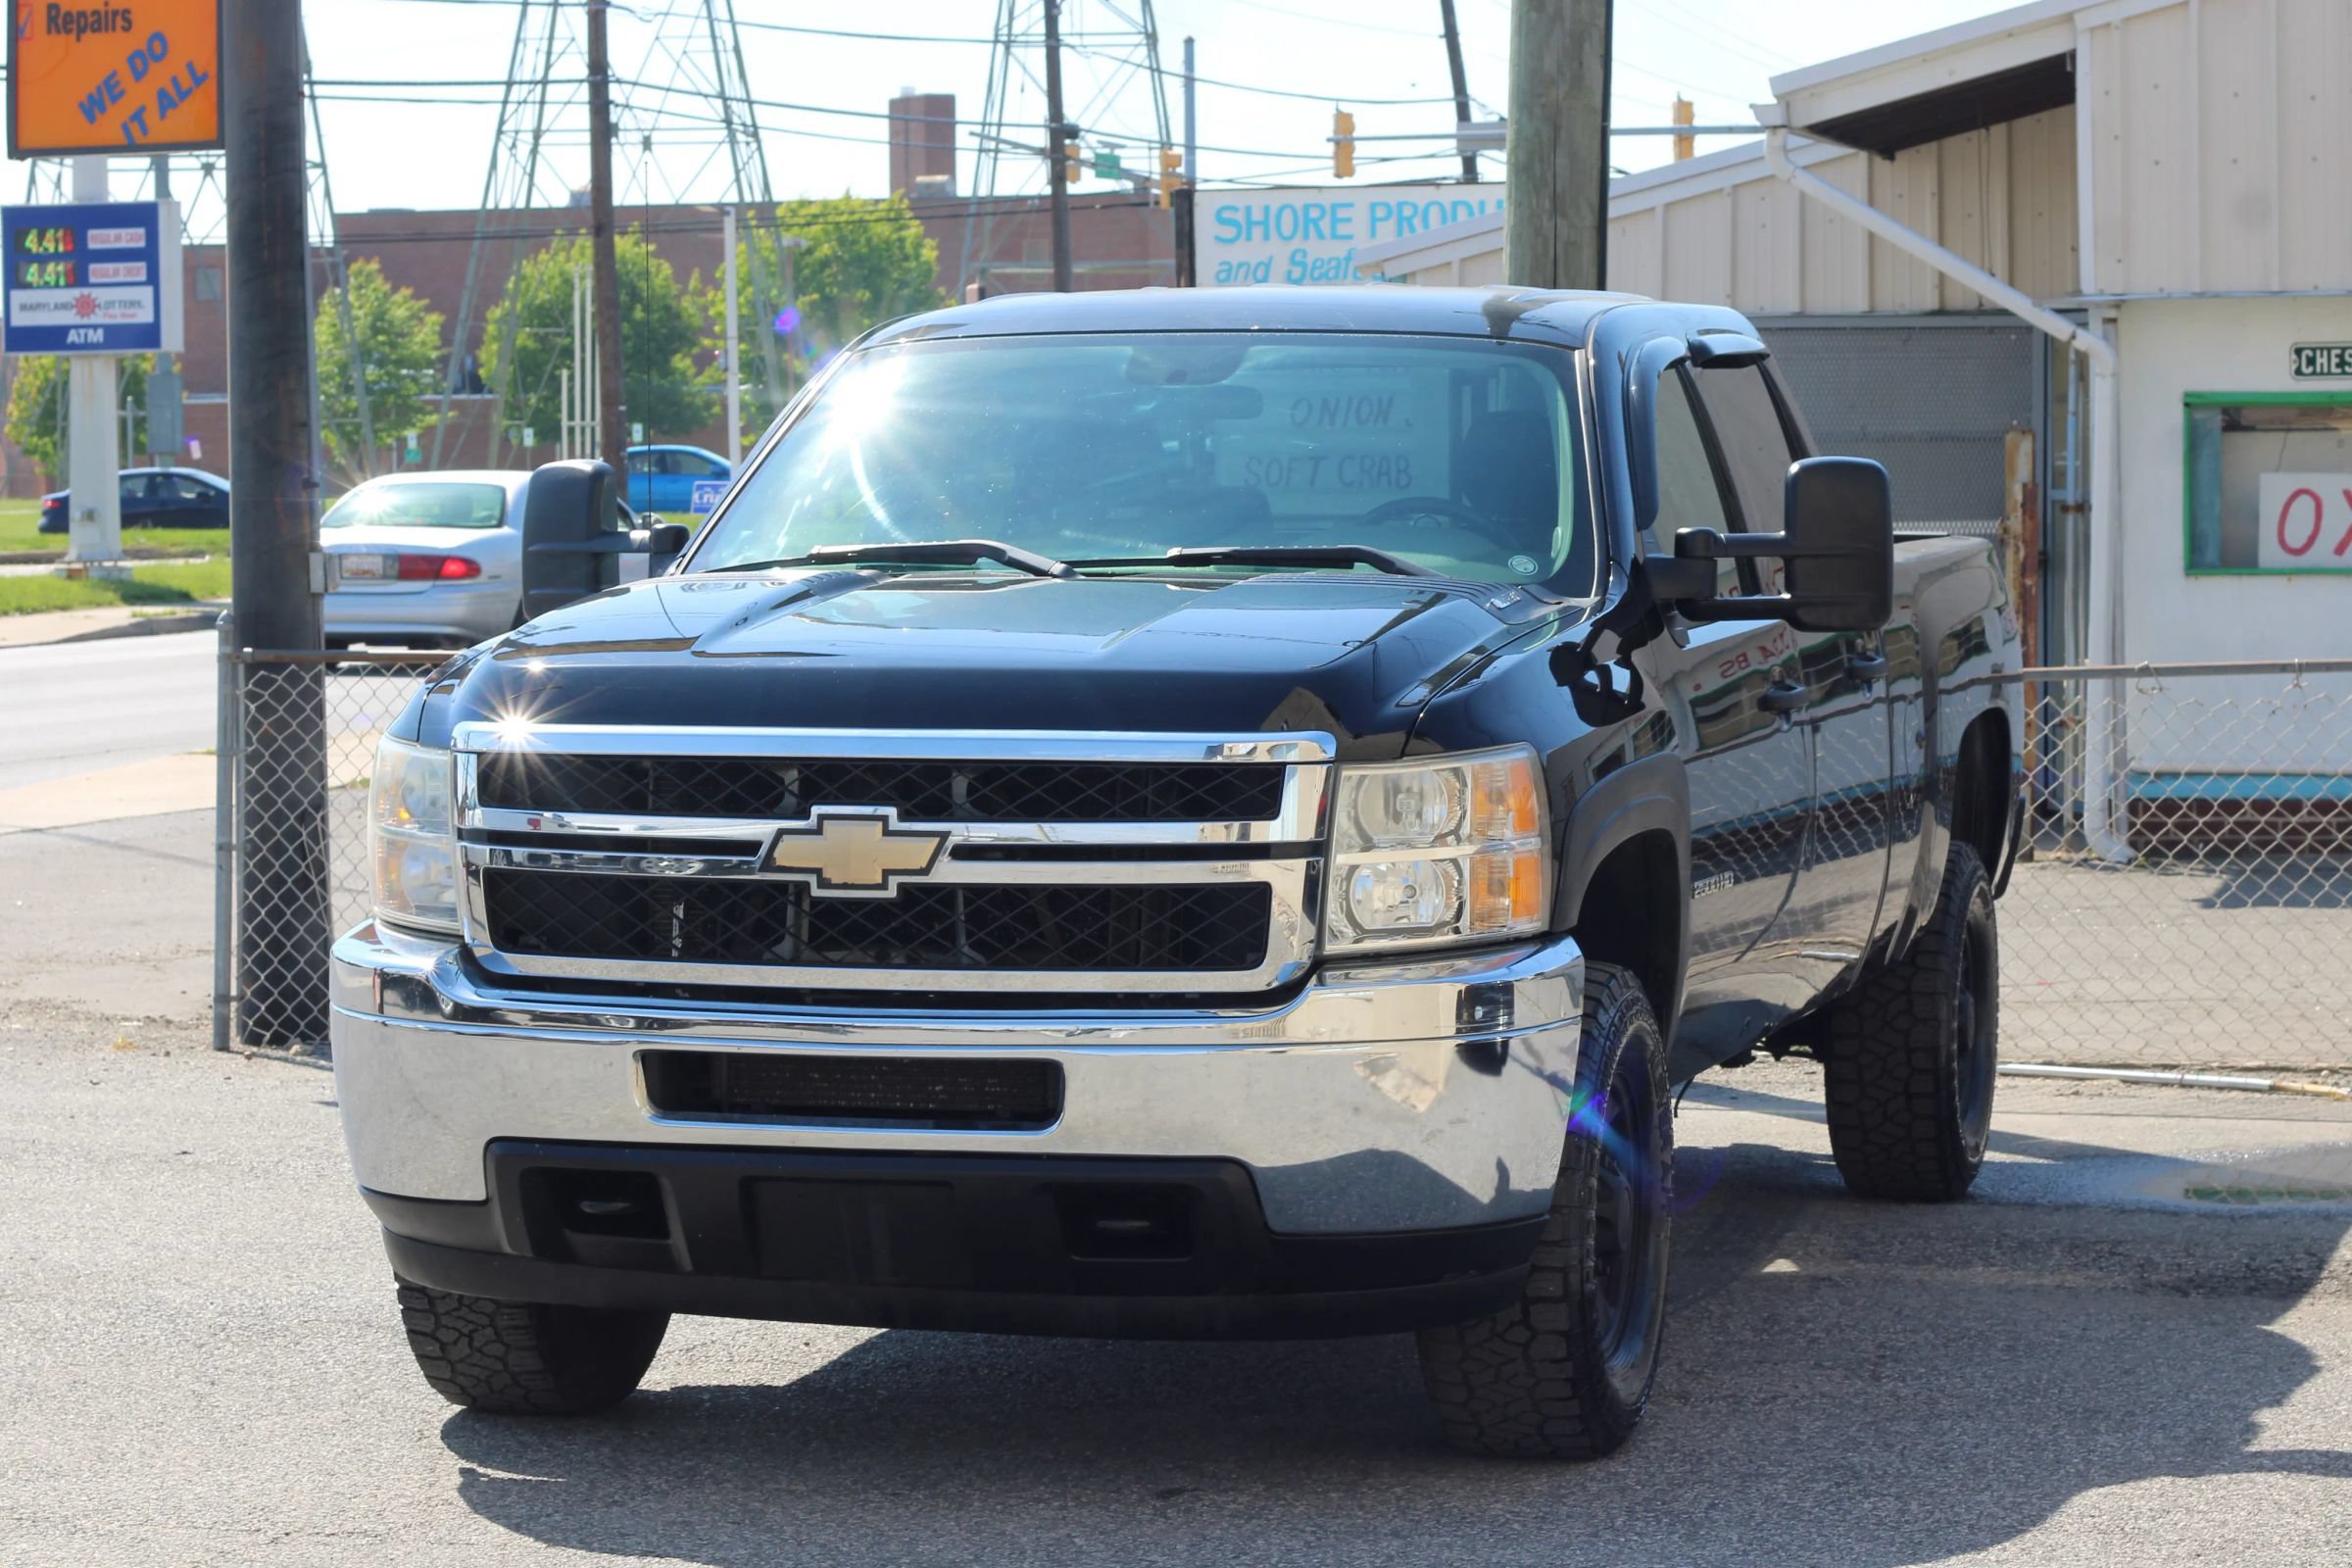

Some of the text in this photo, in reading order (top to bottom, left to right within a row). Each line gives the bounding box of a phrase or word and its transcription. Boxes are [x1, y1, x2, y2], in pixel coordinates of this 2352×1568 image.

[46, 2, 132, 42] Repairs
[78, 31, 169, 125] WE DO
[121, 61, 210, 146] IT ALL
[1214, 203, 1354, 244] SHORE
[1214, 255, 1274, 284] and
[67, 328, 104, 344] ATM
[1245, 454, 1412, 490] SOFT CRAB
